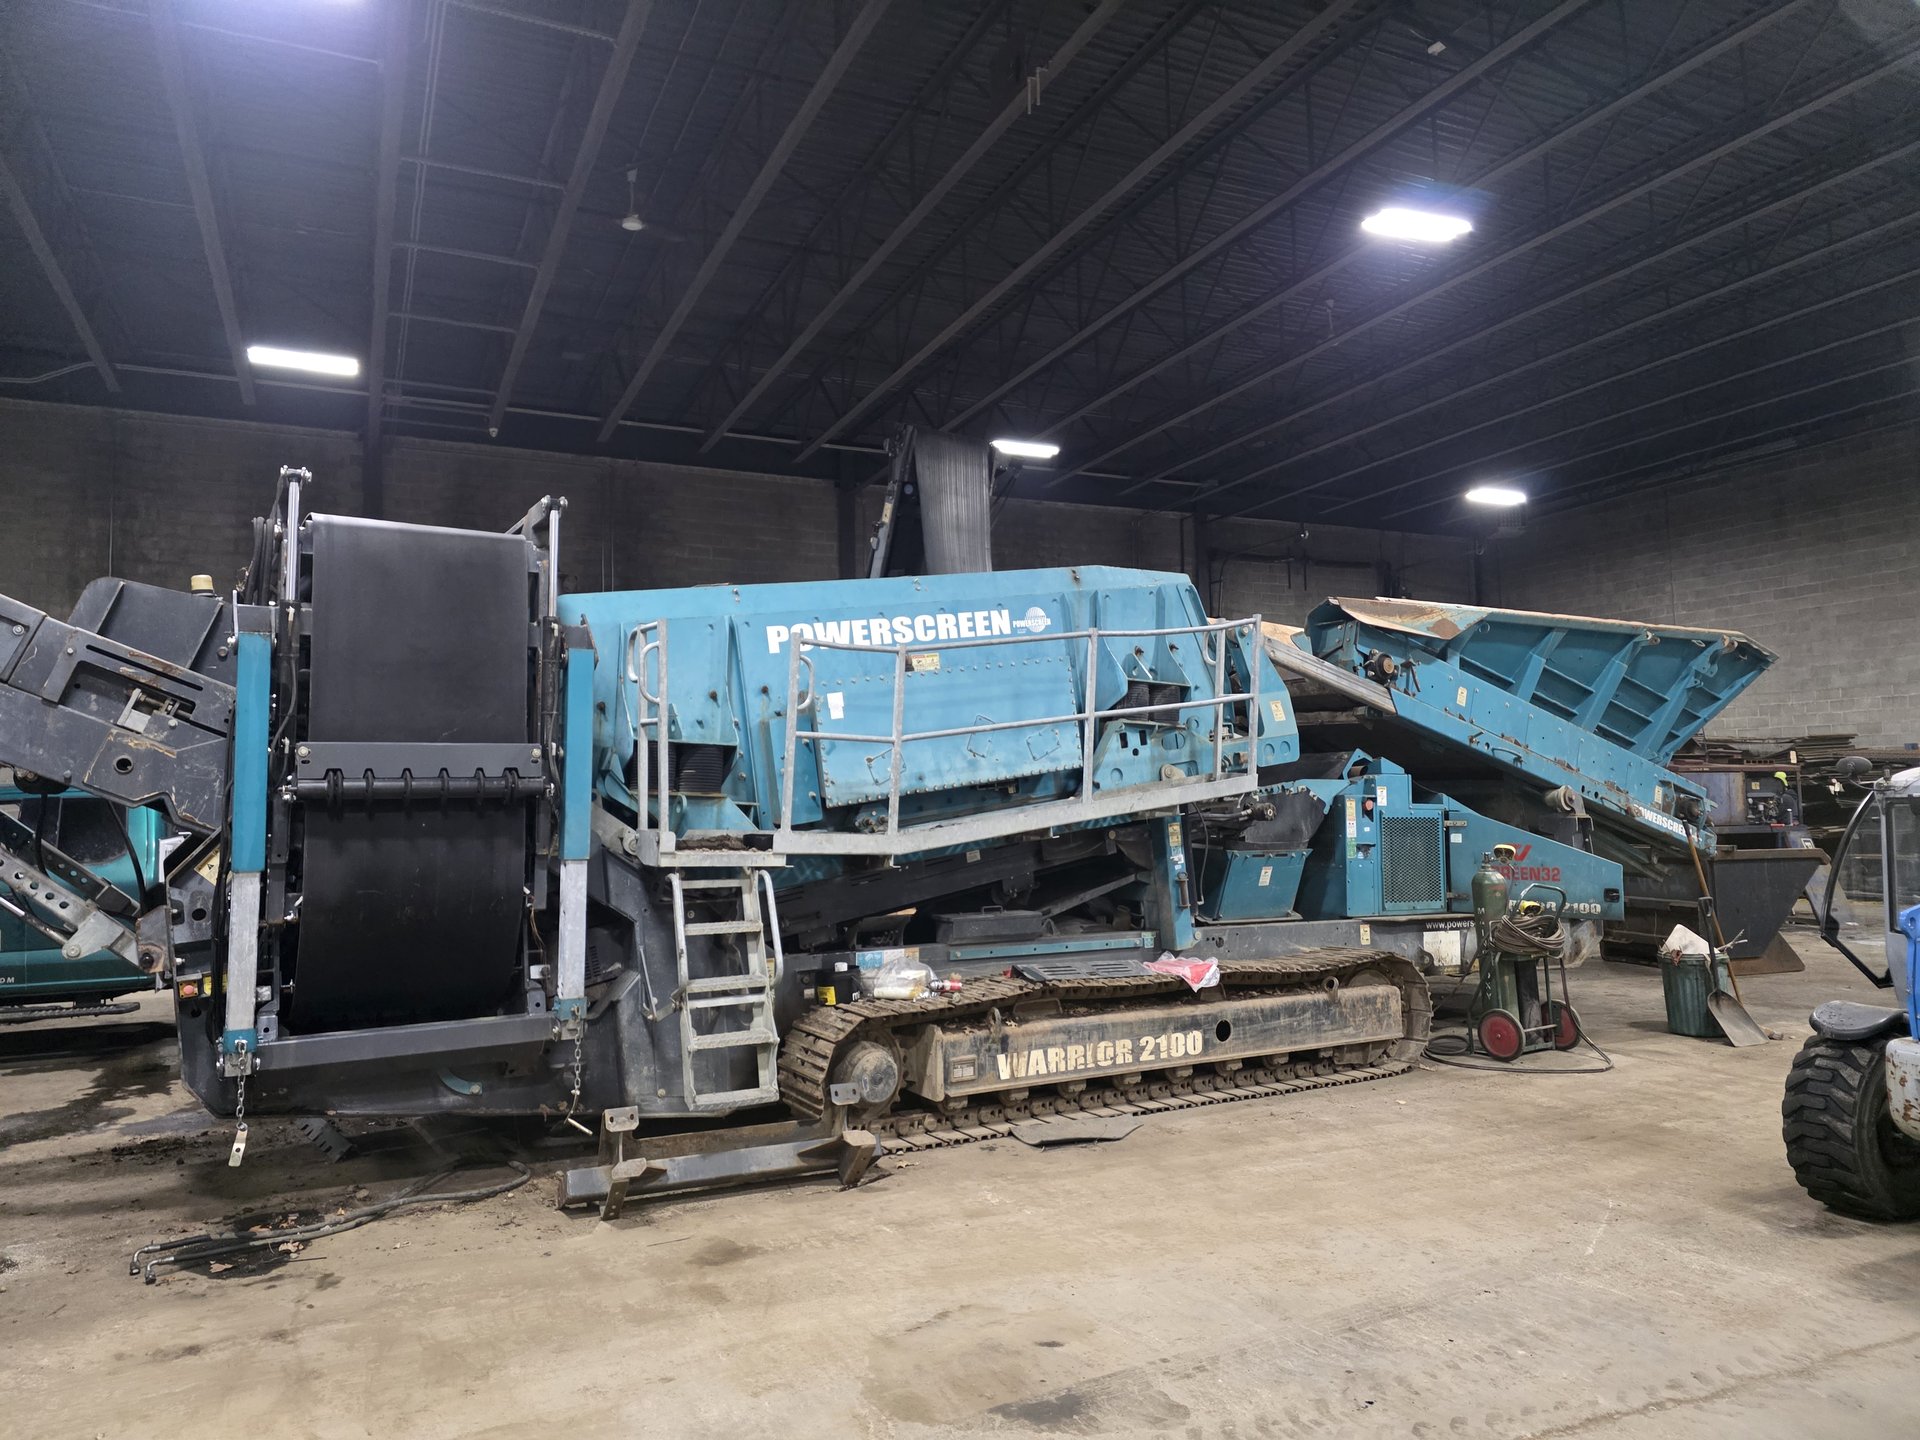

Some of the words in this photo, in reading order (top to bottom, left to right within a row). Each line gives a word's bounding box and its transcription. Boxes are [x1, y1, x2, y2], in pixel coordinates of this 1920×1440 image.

[766, 609, 1012, 653] POWERSCREEN
[996, 1038, 1133, 1080] WARRIOR
[1139, 1030, 1203, 1061] 2100
